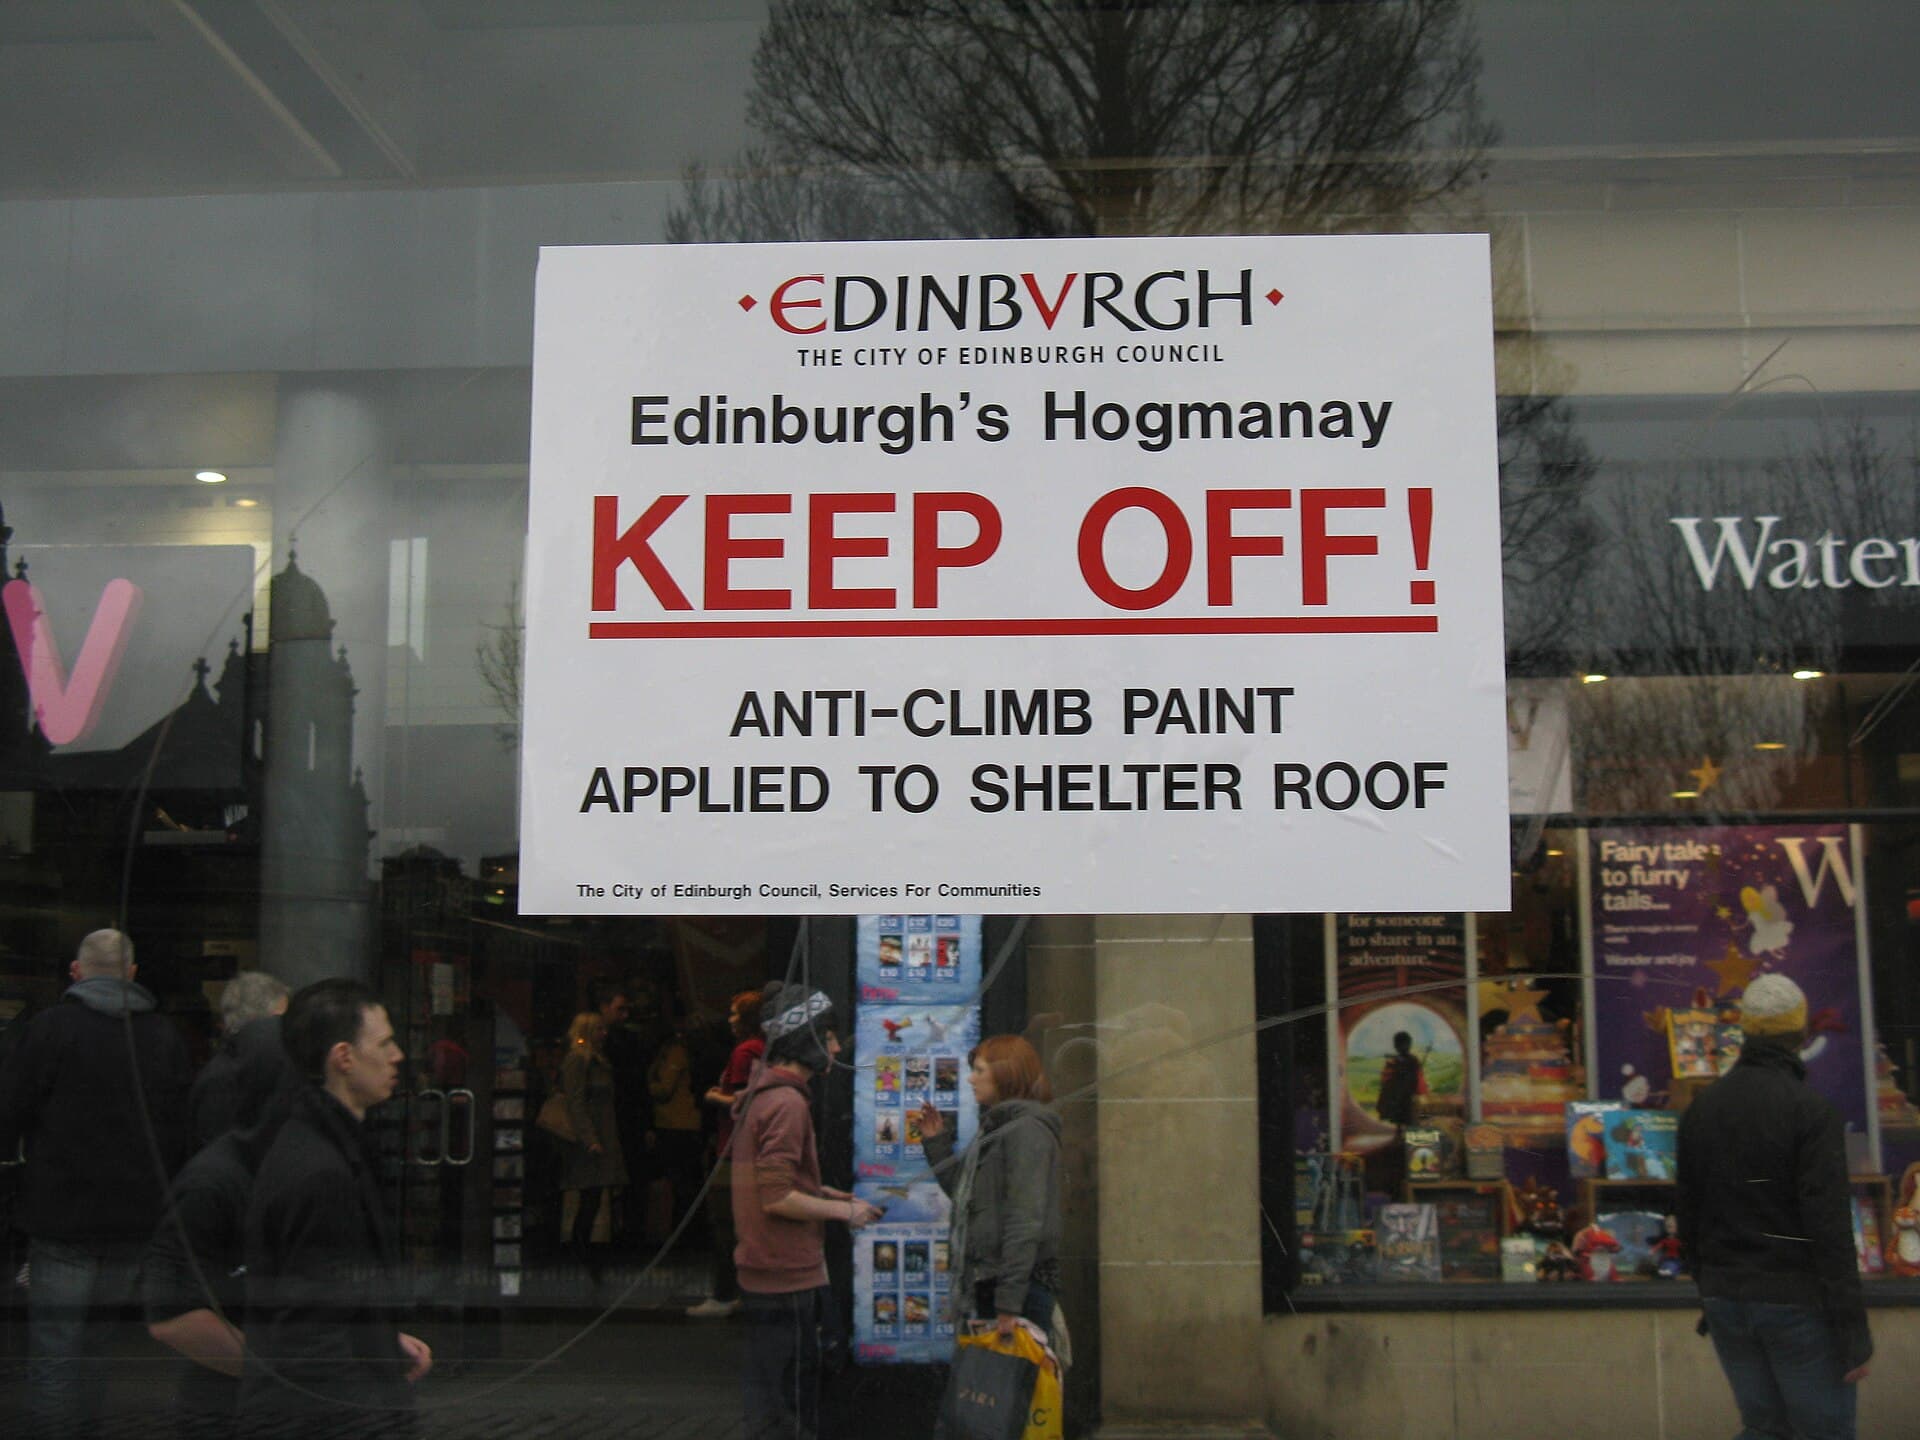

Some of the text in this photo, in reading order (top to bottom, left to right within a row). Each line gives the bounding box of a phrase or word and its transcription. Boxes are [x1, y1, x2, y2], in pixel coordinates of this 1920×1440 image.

[797, 344, 1224, 367] THE CITY OF EDINBURGH COUNCIL
[631, 390, 1393, 455] Edinburgh's Hogmanay
[591, 486, 1436, 612] KEEP OFF!
[729, 687, 1295, 738] ANTI-CLIMB PAINT
[579, 760, 1449, 814] APPLIED TO SHELTER ROOF
[1600, 839, 1660, 865] Fairy
[1602, 865, 1690, 890] to furry
[576, 883, 1041, 900] The City of Edinburgh Council, Services For Communities
[1349, 934, 1367, 946] to
[1416, 931, 1433, 946] in
[1436, 934, 1457, 946] an
